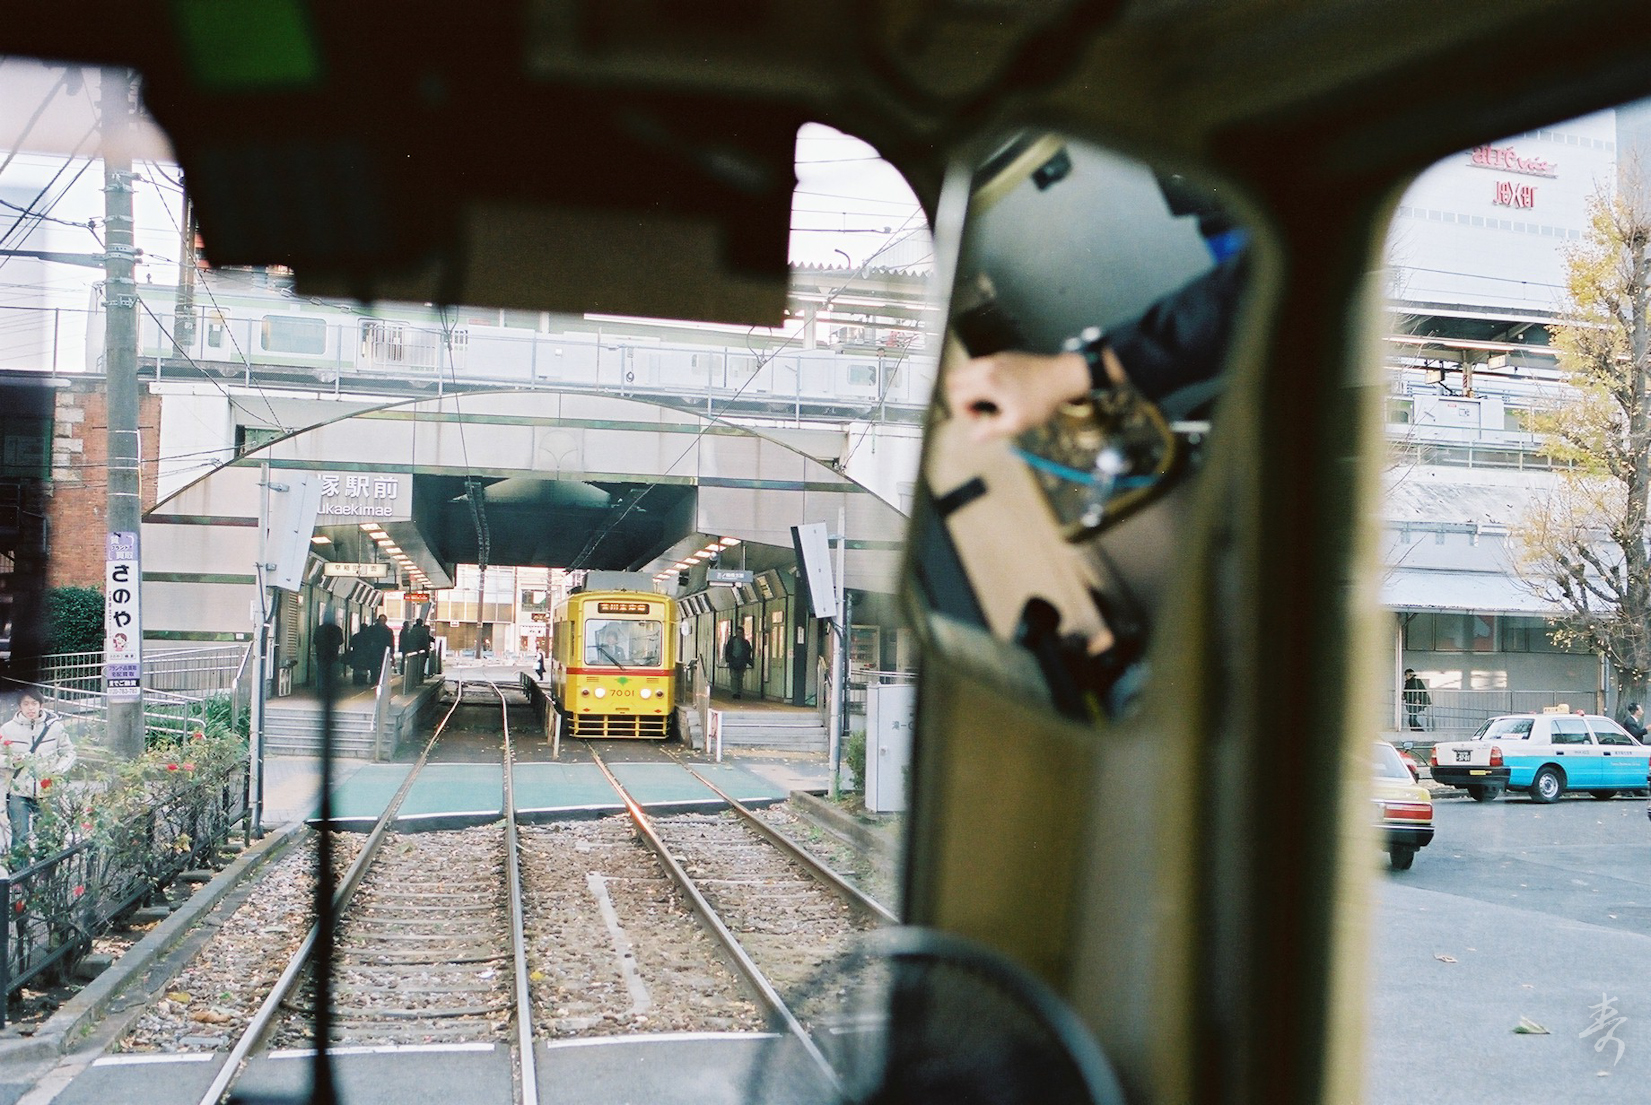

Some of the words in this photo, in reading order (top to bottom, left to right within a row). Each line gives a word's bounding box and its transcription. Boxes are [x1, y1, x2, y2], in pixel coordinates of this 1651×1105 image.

[112, 564, 131, 628] さのや
[610, 689, 635, 697] 7001
